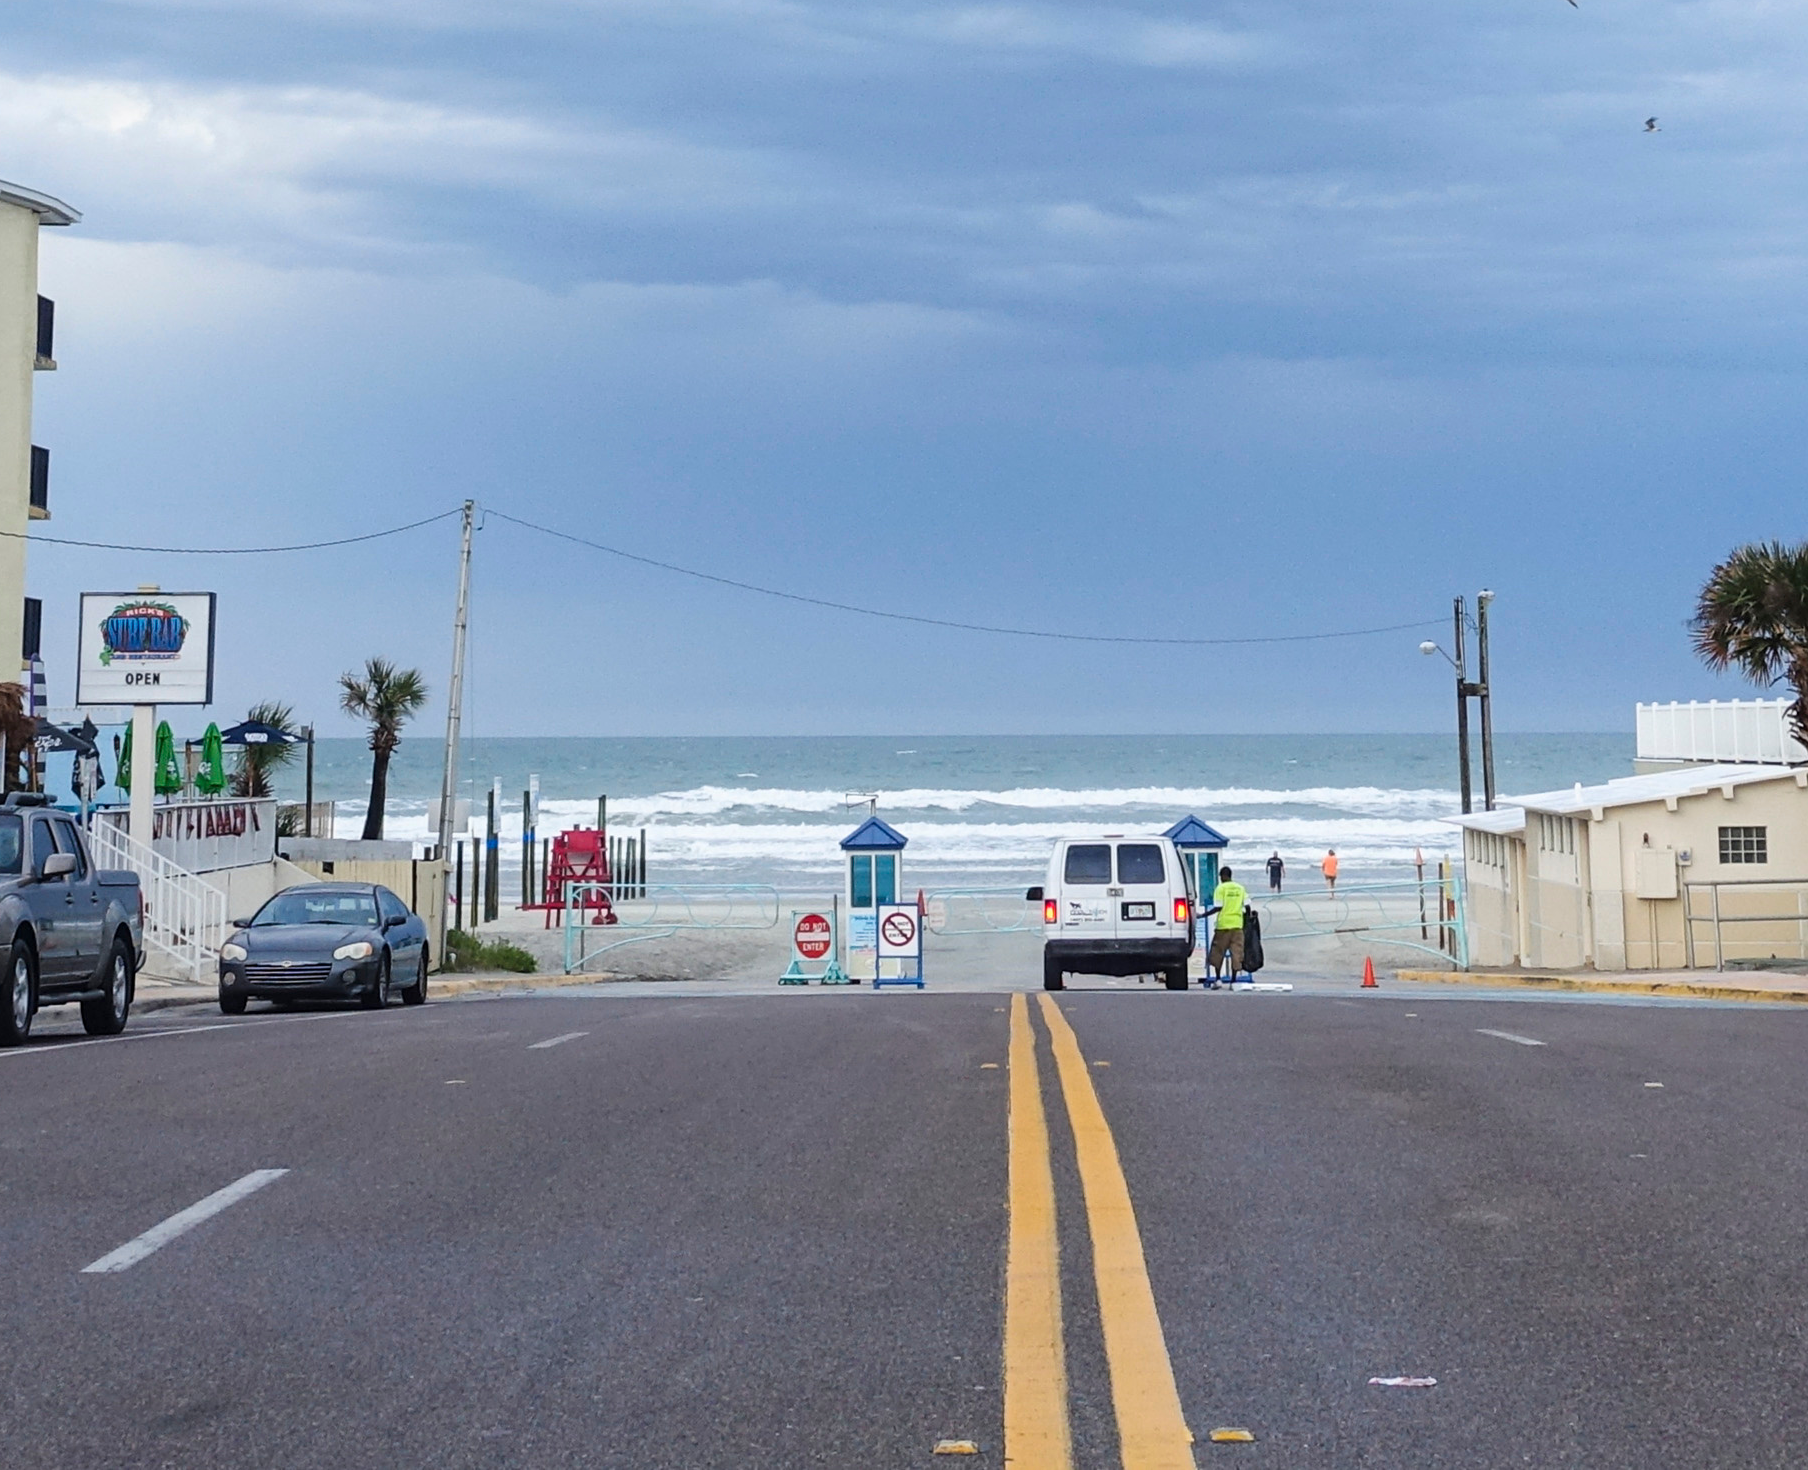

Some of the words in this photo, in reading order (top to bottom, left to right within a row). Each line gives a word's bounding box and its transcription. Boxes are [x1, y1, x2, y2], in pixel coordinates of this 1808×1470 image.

[125, 672, 161, 685] OPEN
[799, 922, 810, 931] DO
[802, 942, 825, 951] ENTER
